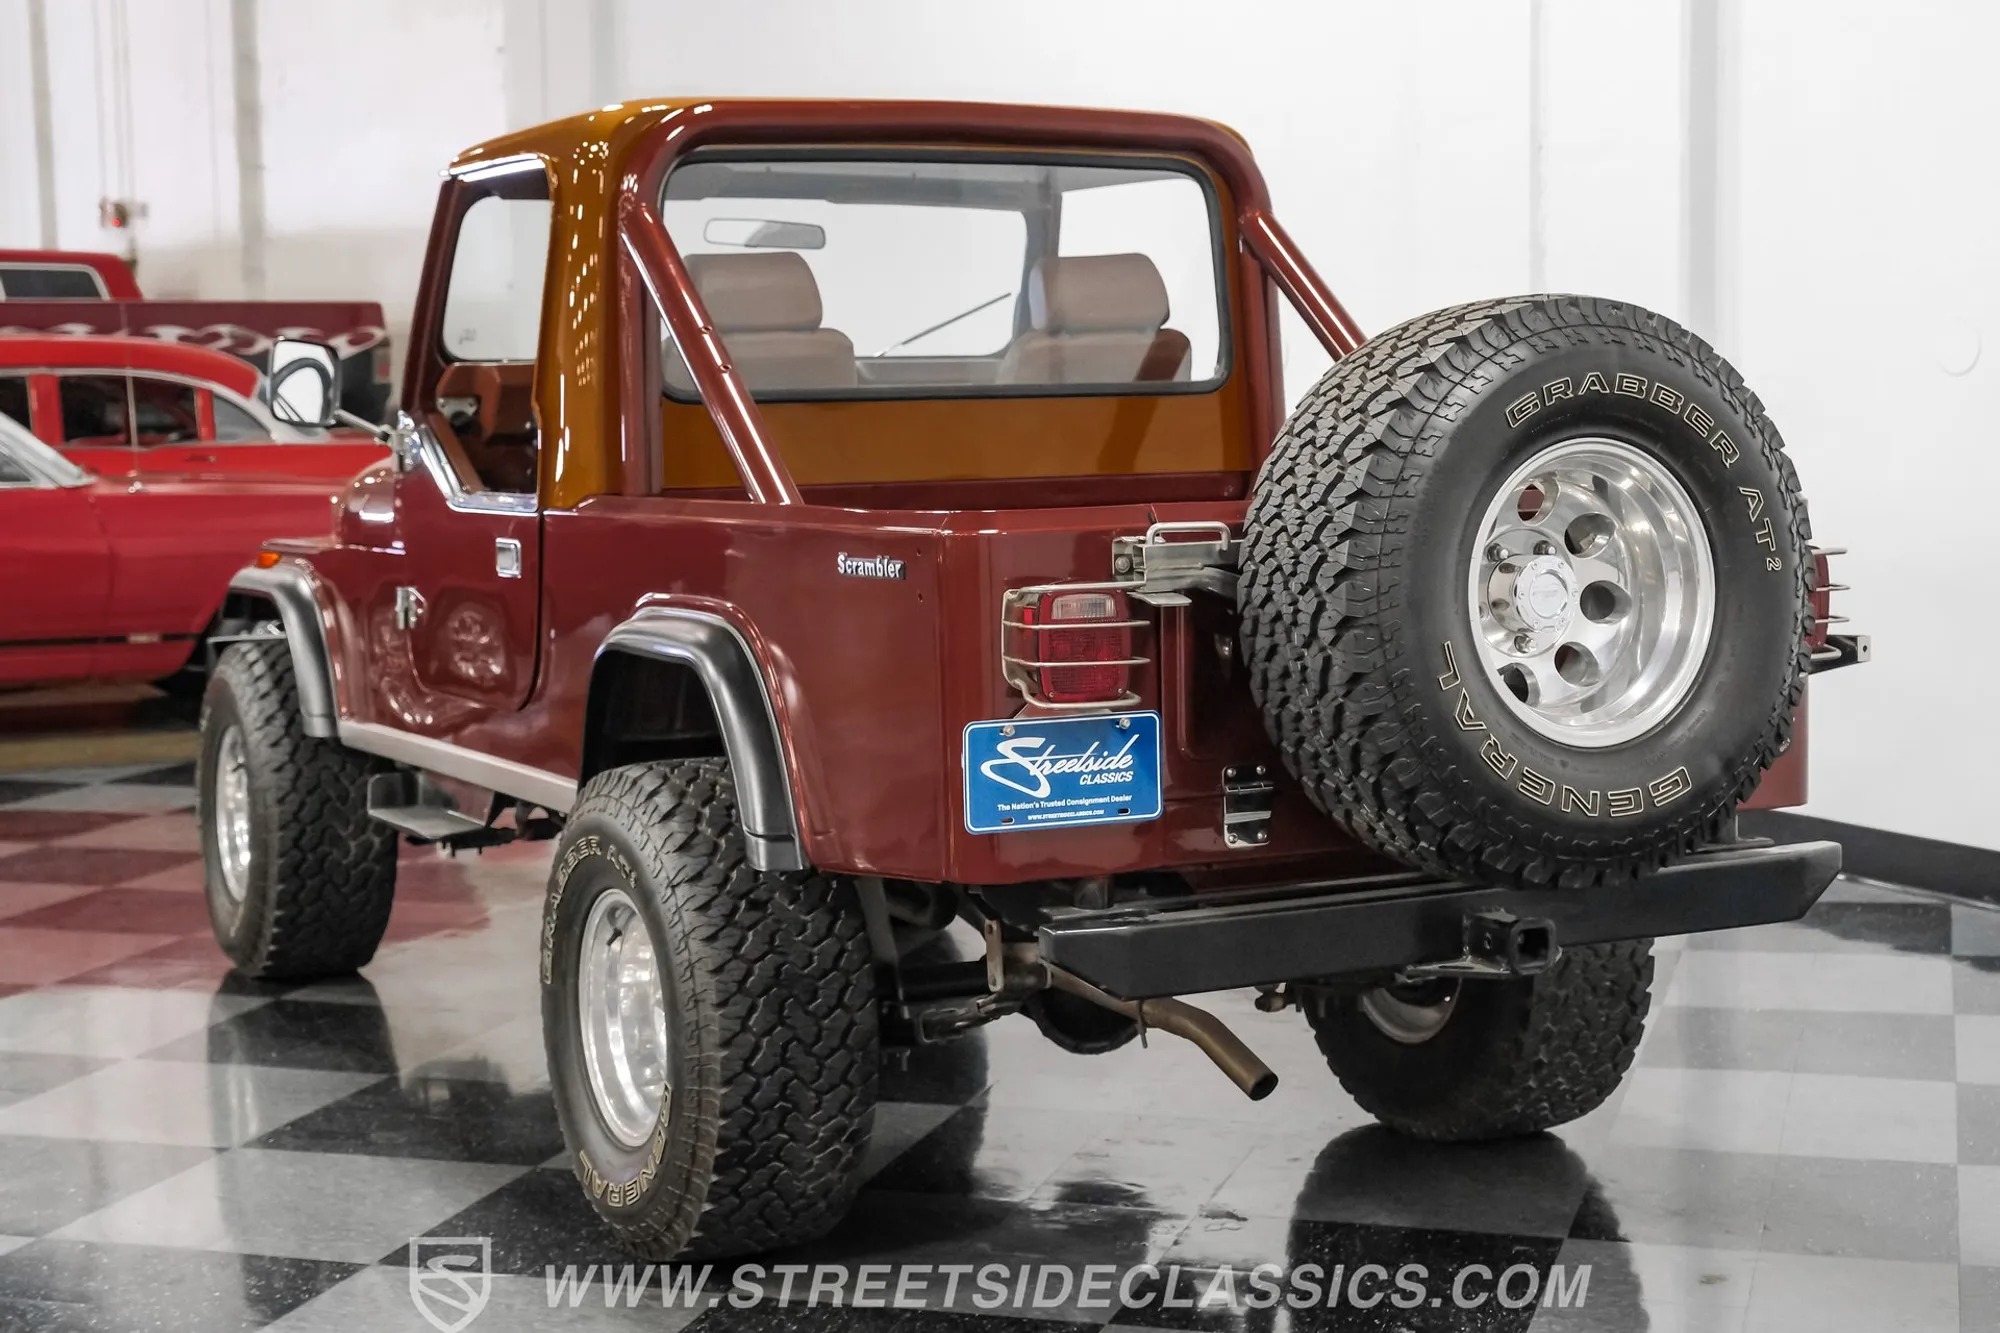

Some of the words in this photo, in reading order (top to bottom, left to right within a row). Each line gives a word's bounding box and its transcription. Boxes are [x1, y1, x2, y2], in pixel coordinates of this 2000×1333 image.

[1505, 372, 1740, 468] GRABBER
[837, 553, 901, 578] Scrambler
[1437, 641, 1692, 817] GENERAL
[980, 734, 1140, 798] Streetside
[1079, 771, 1134, 786] CLASSICS
[997, 803, 1011, 811] The
[1011, 800, 1040, 810] Nation's
[1040, 799, 1066, 808] Trusted
[1066, 796, 1110, 806] Consignment
[1110, 794, 1133, 803] Dealer
[579, 1080, 671, 1207] GENERAL
